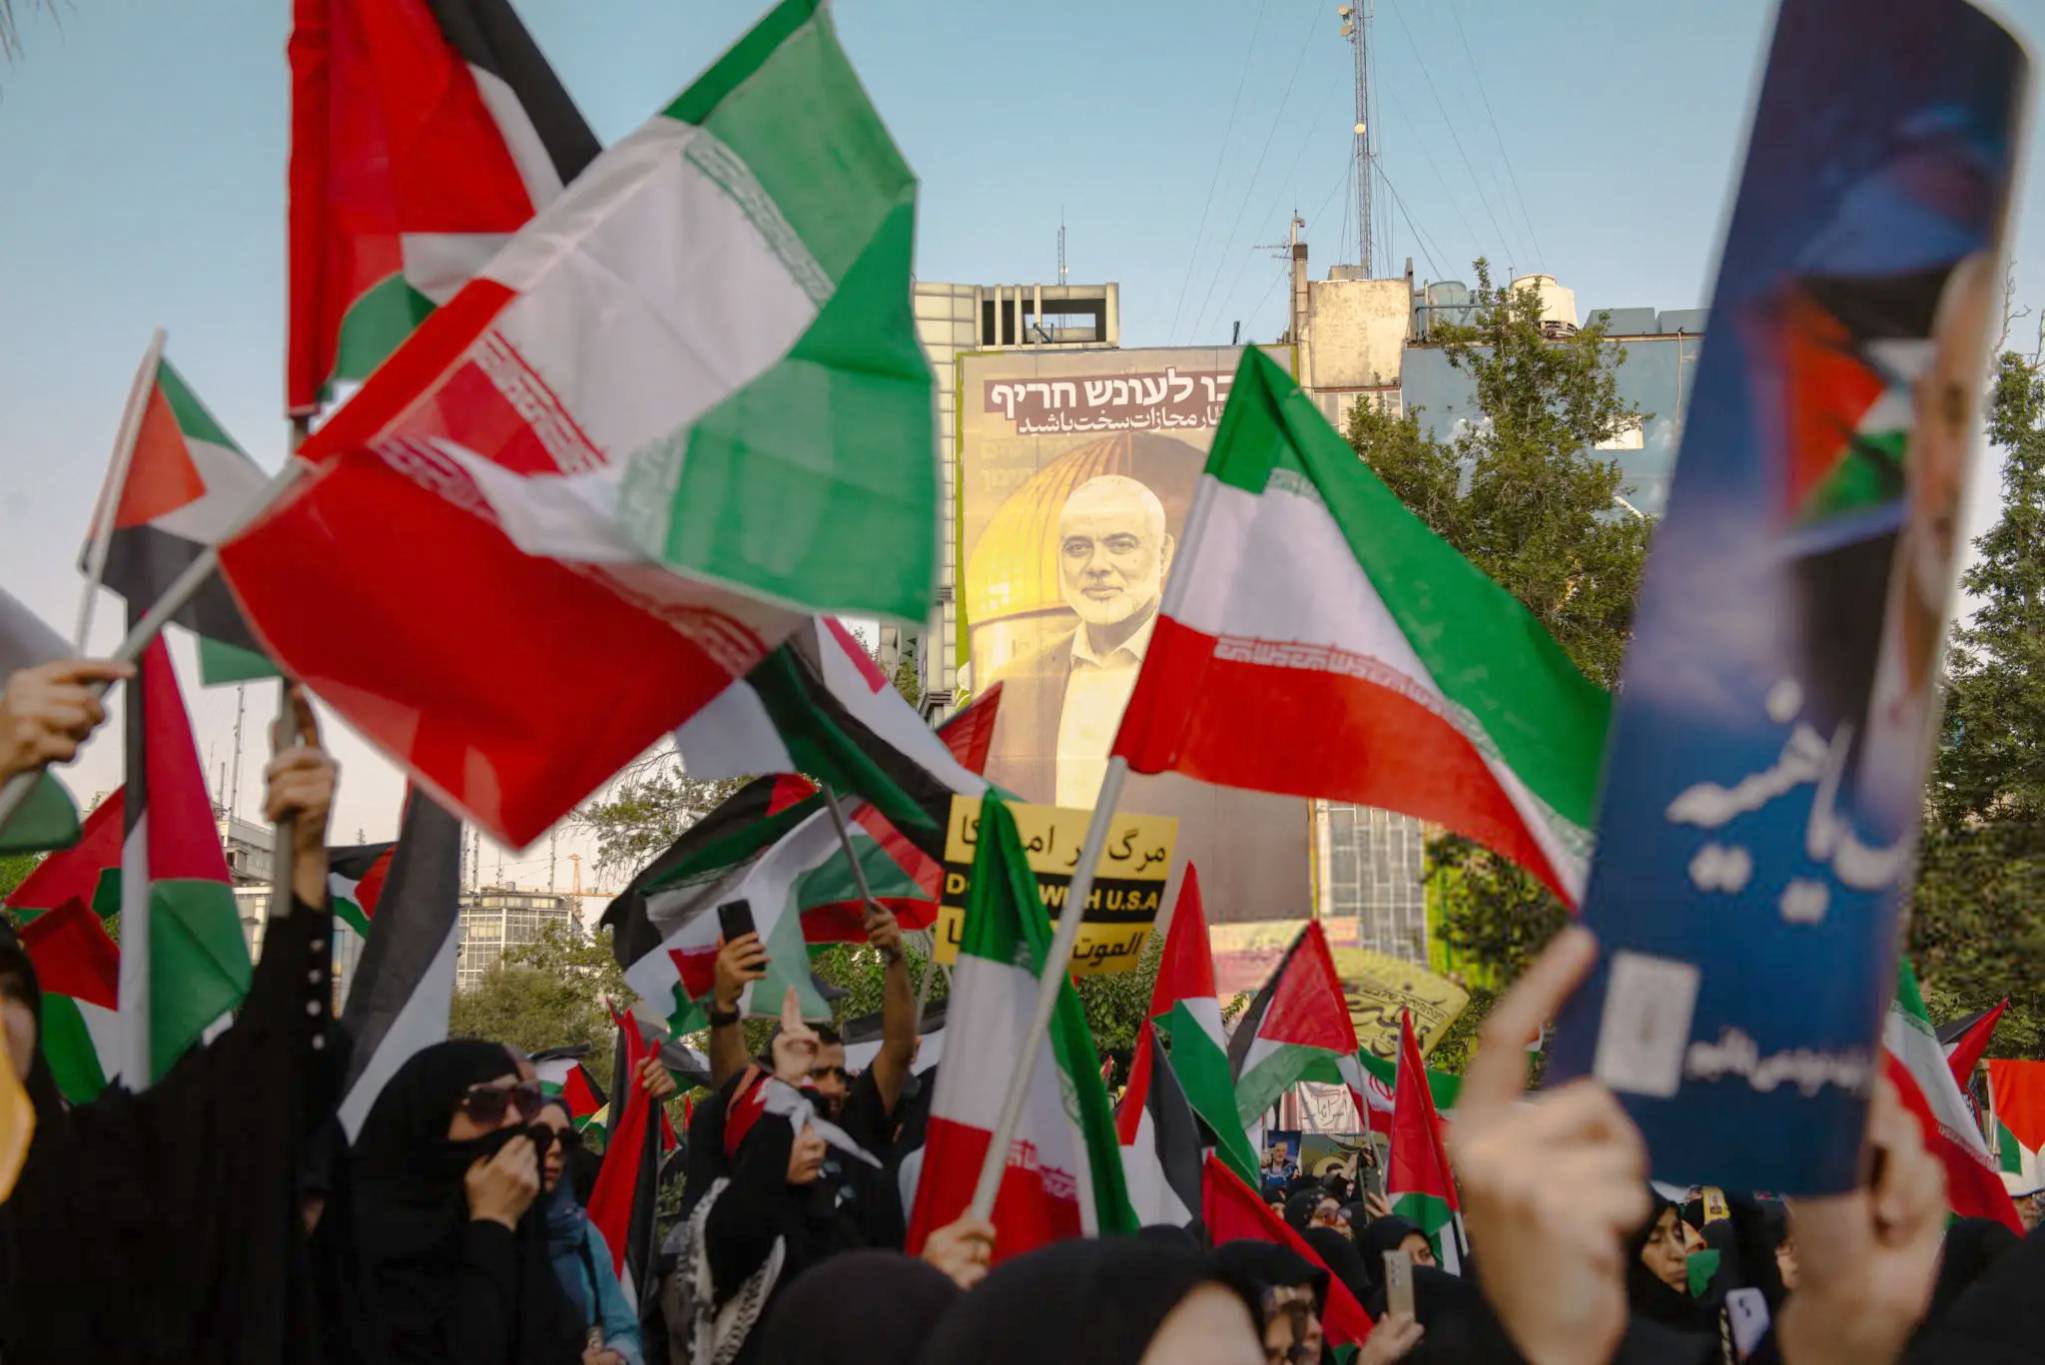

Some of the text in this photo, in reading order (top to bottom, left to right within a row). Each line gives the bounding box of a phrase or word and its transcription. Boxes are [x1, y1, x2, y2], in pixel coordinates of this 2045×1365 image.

[991, 367, 1234, 419] כו לעונש חריף
[1018, 410, 1074, 437] باشید
[1075, 408, 1130, 431] سخت
[1131, 405, 1198, 432] مجازات
[1108, 827, 1167, 872] مرگ
[1072, 931, 1144, 967] الموت
